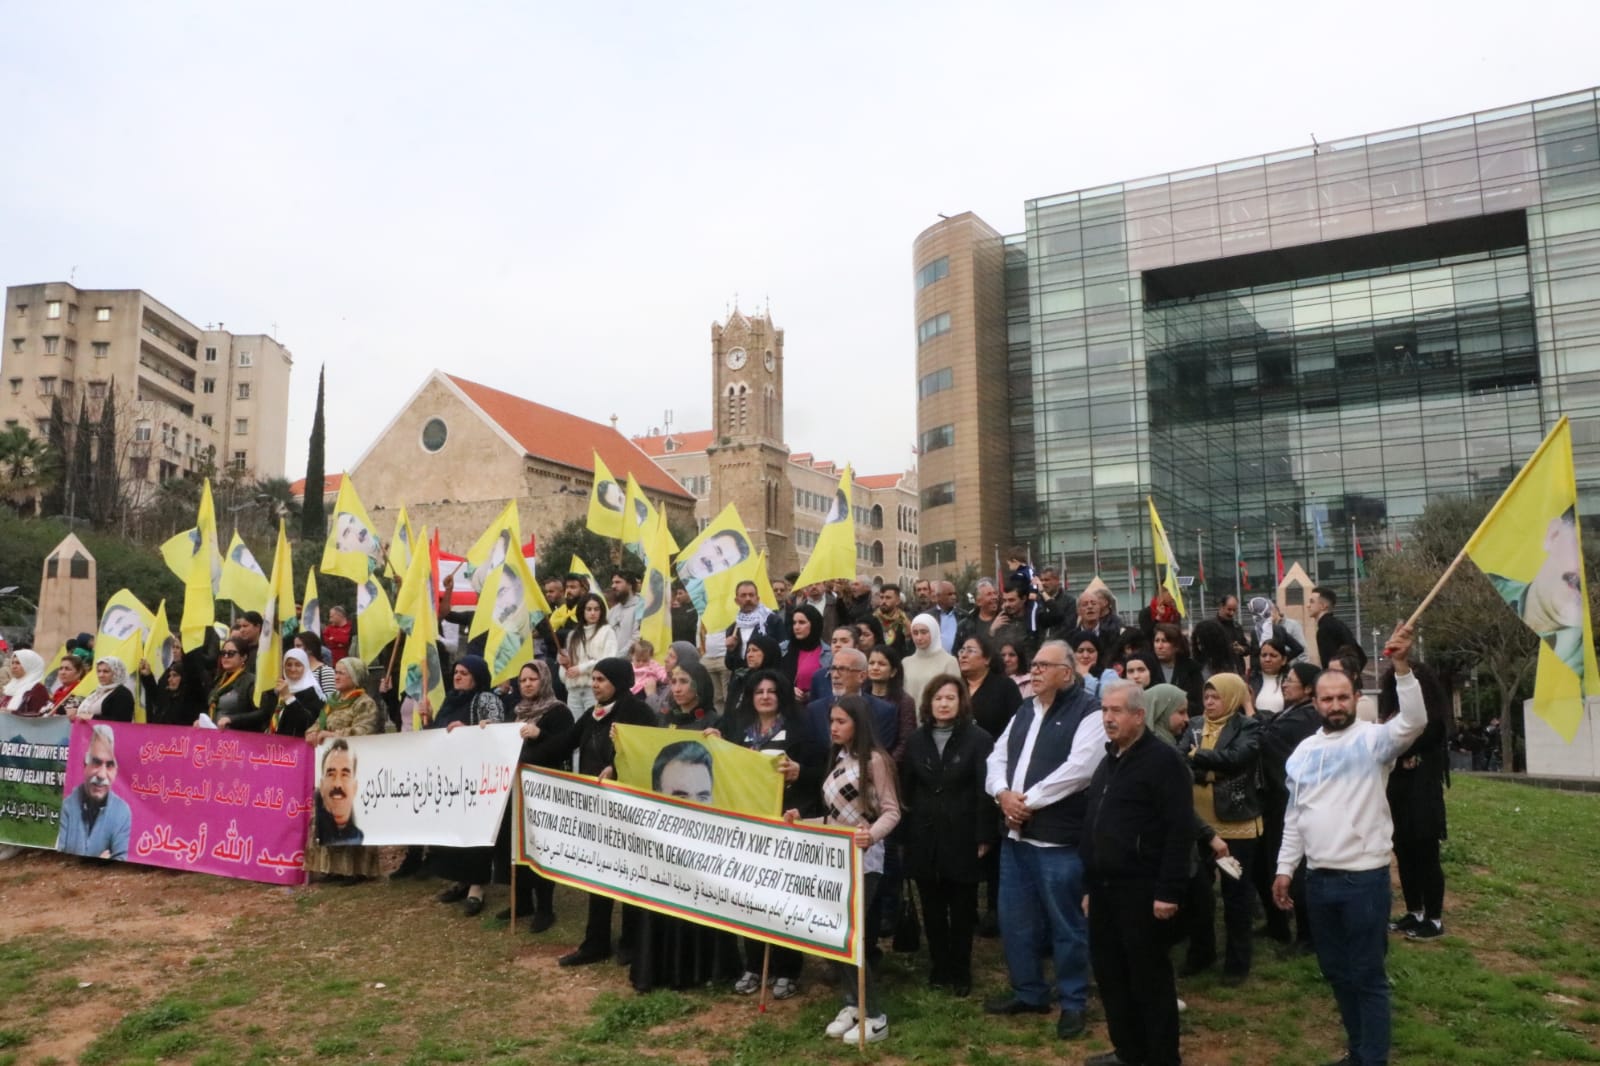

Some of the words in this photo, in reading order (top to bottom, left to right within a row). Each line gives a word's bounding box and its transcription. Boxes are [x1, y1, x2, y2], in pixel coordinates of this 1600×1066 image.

[140, 736, 190, 763] الفوري
[250, 744, 298, 770] نطالب
[45, 771, 56, 786] RE
[253, 787, 283, 810] قائد
[390, 768, 410, 808] شعبنا
[413, 767, 432, 813] تاريخ
[434, 765, 442, 813] في
[464, 776, 478, 812] يوم
[136, 822, 207, 863] أوجلان
[212, 820, 253, 864] الله
[601, 798, 608, 816] LI
[608, 801, 661, 829] BERAMBERÎ
[657, 814, 747, 850] BERPIRSIYARIYÊN
[746, 833, 773, 856] XWE
[773, 836, 795, 860] YÊN
[794, 839, 824, 866] DÎROKÎ
[825, 847, 836, 868] YE
[837, 849, 845, 869] DI
[257, 848, 305, 875] عبد
[558, 816, 578, 836] GELÊ
[578, 821, 596, 842] KURD
[597, 823, 603, 843] Û
[604, 825, 626, 850] HÊZÊN
[665, 844, 728, 875] DEMOKRATÎK
[723, 857, 745, 879] ÊN
[740, 864, 758, 882] KU
[755, 867, 784, 890] ŞERÎ
[781, 872, 818, 897] TERORÊ
[817, 879, 843, 902] KIRIN
